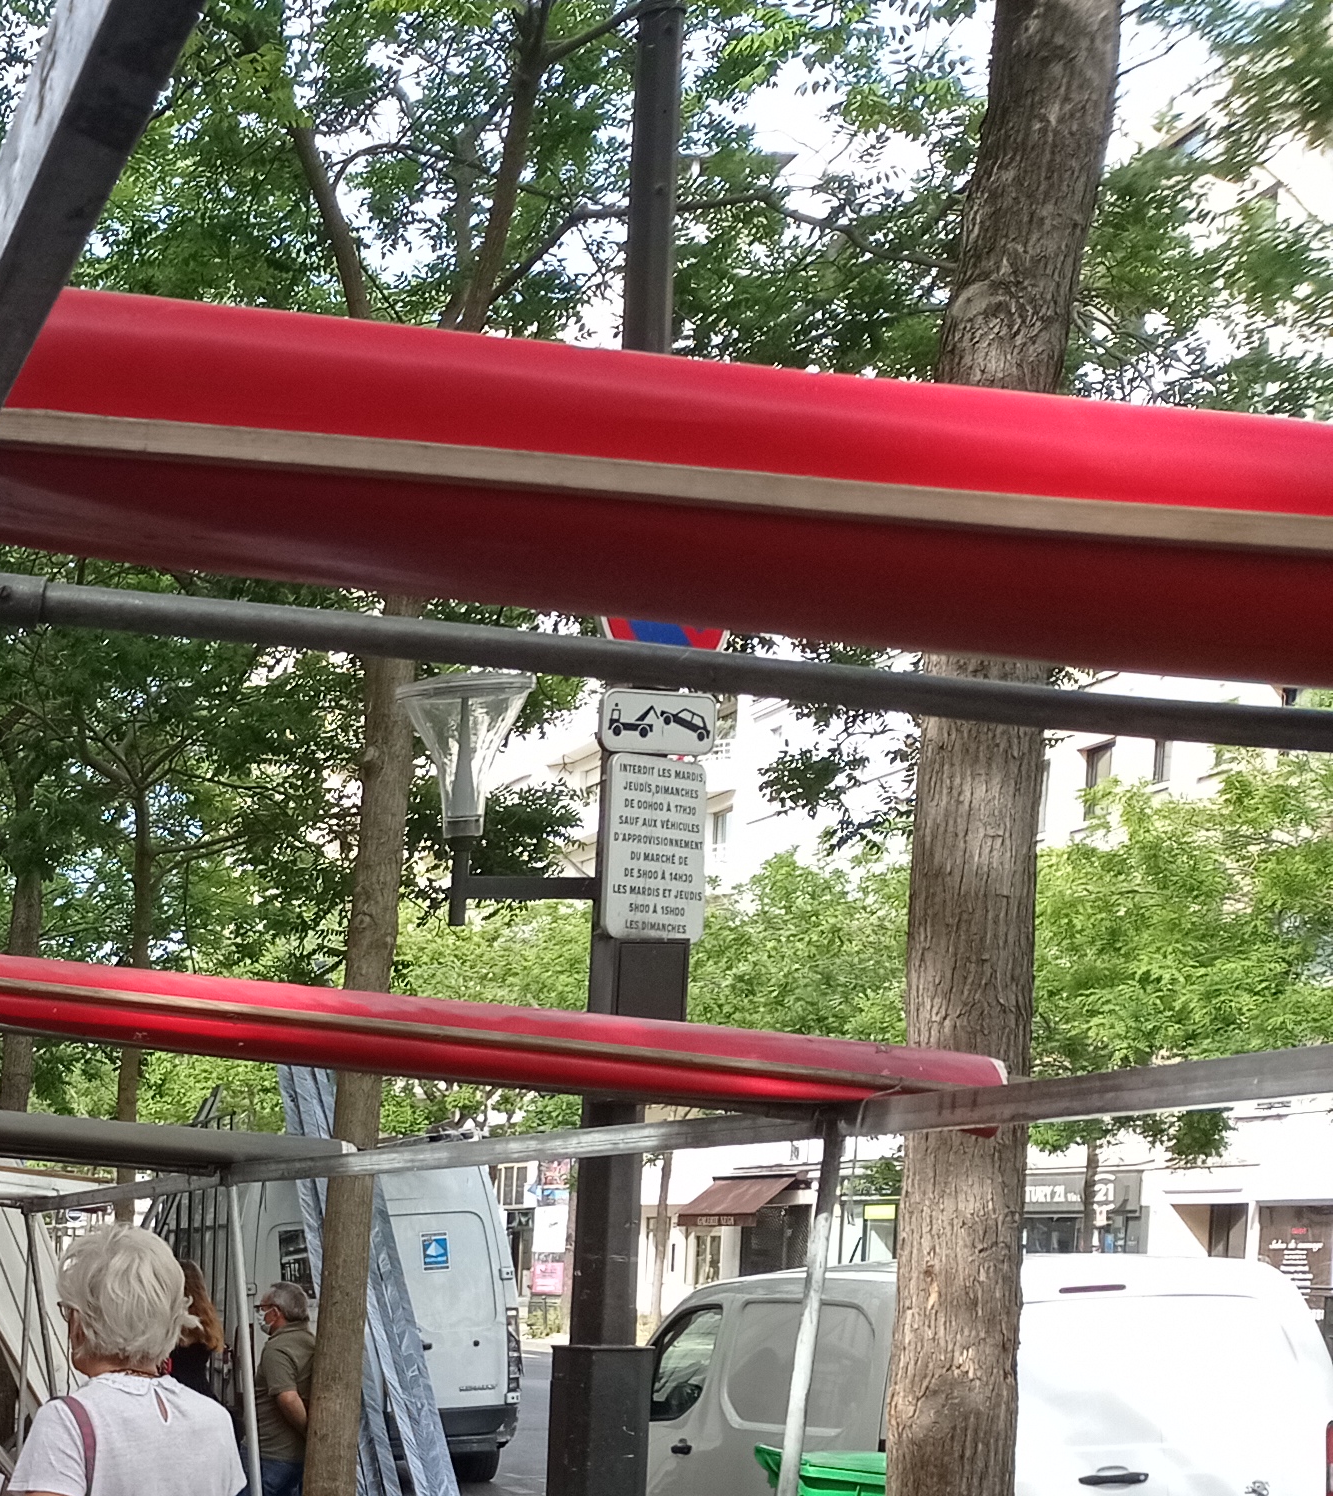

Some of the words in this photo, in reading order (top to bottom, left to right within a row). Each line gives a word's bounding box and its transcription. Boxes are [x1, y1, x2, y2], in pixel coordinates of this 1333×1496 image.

[619, 763, 655, 776] INTERDIT
[657, 767, 672, 778] LES
[674, 769, 706, 785] MARDIS,
[624, 798, 635, 808] DE
[637, 800, 664, 811] 00H00
[665, 801, 672, 812] À
[674, 804, 697, 816] 17H30
[618, 815, 640, 825] SAUF
[642, 818, 658, 828] AUX
[660, 819, 700, 833] VÉHICULES
[614, 832, 703, 850] D'APPROVISIONNEMENT
[630, 851, 641, 861] DU
[643, 852, 676, 865] MARCHÉ
[678, 856, 688, 866] DE
[624, 868, 635, 878] DE
[636, 869, 658, 880] 5H00
[660, 869, 666, 881] À
[669, 872, 693, 884] 14H30
[612, 883, 627, 895] LES
[629, 885, 660, 898] MARDIS
[662, 888, 672, 898] ET
[674, 890, 702, 901] JEUDIS
[628, 902, 650, 913] 5H00
[652, 903, 658, 914] À
[660, 906, 685, 917] 15H00
[624, 919, 639, 930] LES
[641, 921, 687, 934] DIMANCHES
[1093, 1183, 1115, 1202] 21
[697, 1216, 719, 1226] GALERIE
